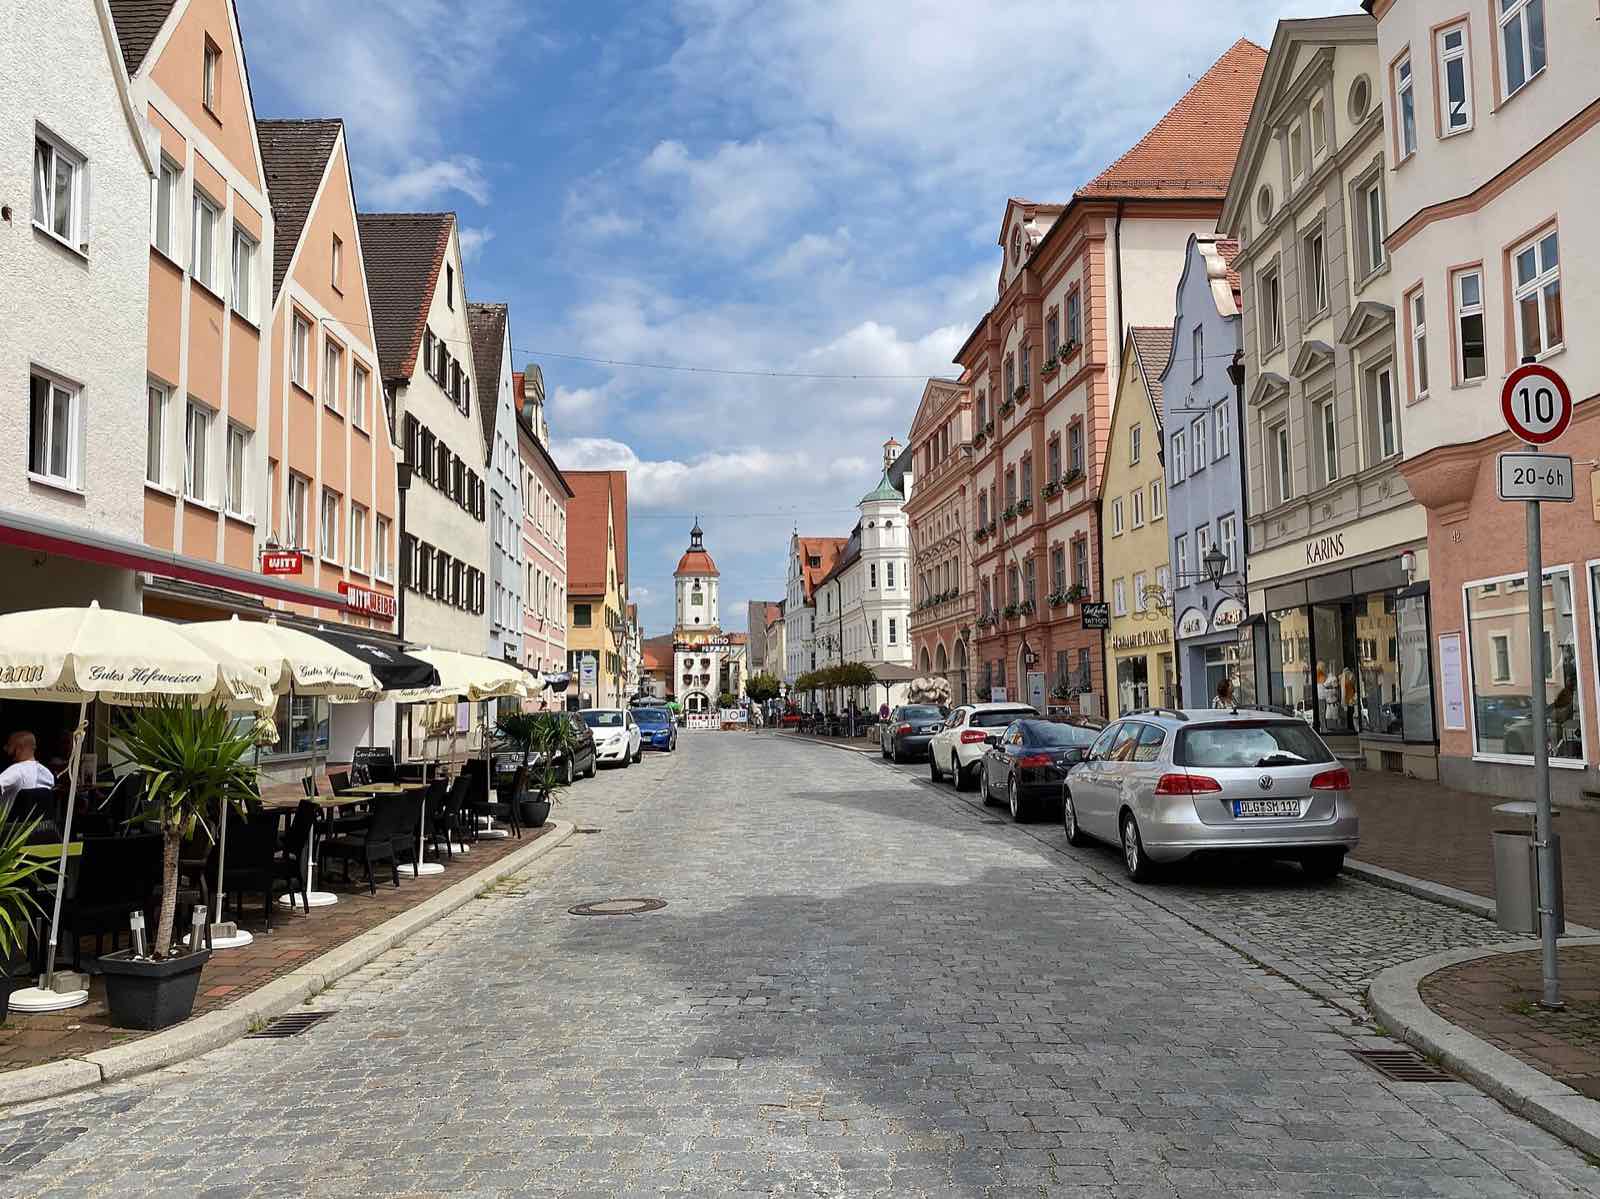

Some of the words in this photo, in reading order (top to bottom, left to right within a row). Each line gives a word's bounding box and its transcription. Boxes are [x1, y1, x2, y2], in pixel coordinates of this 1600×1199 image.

[1519, 388, 1554, 424] 10
[1513, 468, 1564, 486] 20-6h
[1306, 532, 1345, 565] KARINS
[268, 558, 298, 568] WITT
[347, 586, 370, 610] WITT
[1084, 617, 1108, 625] TATTOO
[708, 634, 729, 645] Kino
[88, 665, 124, 681] Gutes
[127, 666, 202, 686] Hefeweizen
